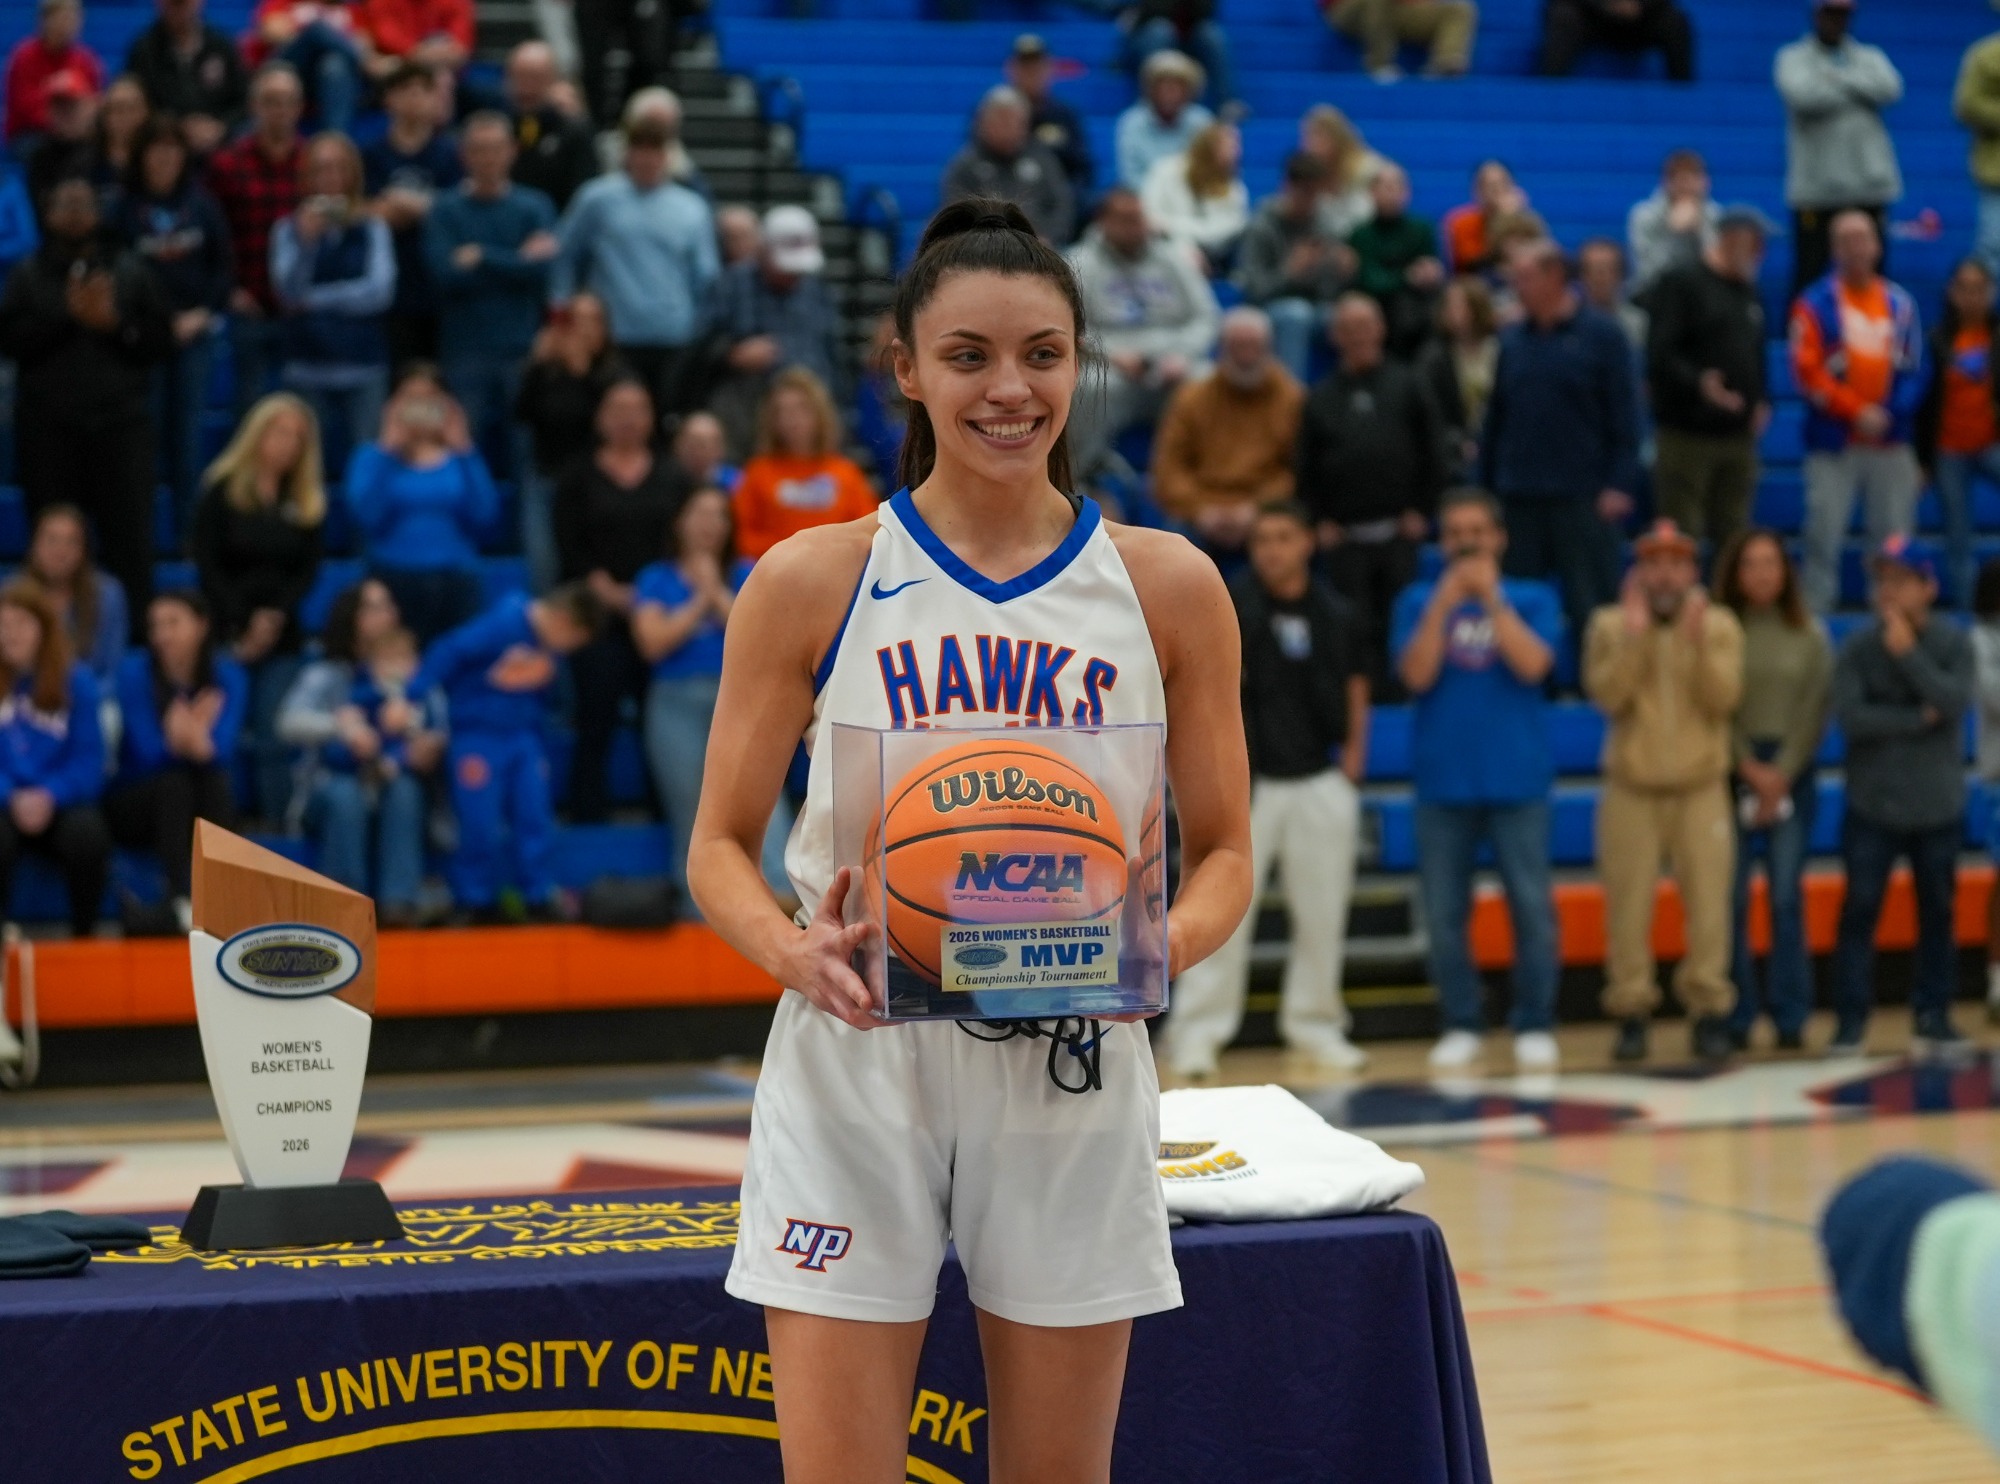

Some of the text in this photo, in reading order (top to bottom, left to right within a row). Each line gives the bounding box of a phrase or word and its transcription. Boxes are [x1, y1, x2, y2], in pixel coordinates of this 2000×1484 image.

[876, 634, 1118, 727] HAWKS
[927, 766, 1099, 824] Wilson
[954, 852, 1084, 893] NCAA
[953, 894, 1081, 904] OFFICIAL GAME BALL
[949, 925, 1111, 943] 2026 WOMEN'S BASKETBALL
[1021, 942, 1104, 968] MVP
[956, 969, 1108, 987] Championship Tournament
[262, 1040, 322, 1055] WOMEN'S
[251, 1058, 335, 1074] BASKETBALL
[257, 1099, 332, 1115] CHAMPIONS
[282, 1139, 310, 1152] 2026
[777, 1219, 852, 1271] NP
[121, 1340, 987, 1480] STATE UNIVERSITY OF NE RK
